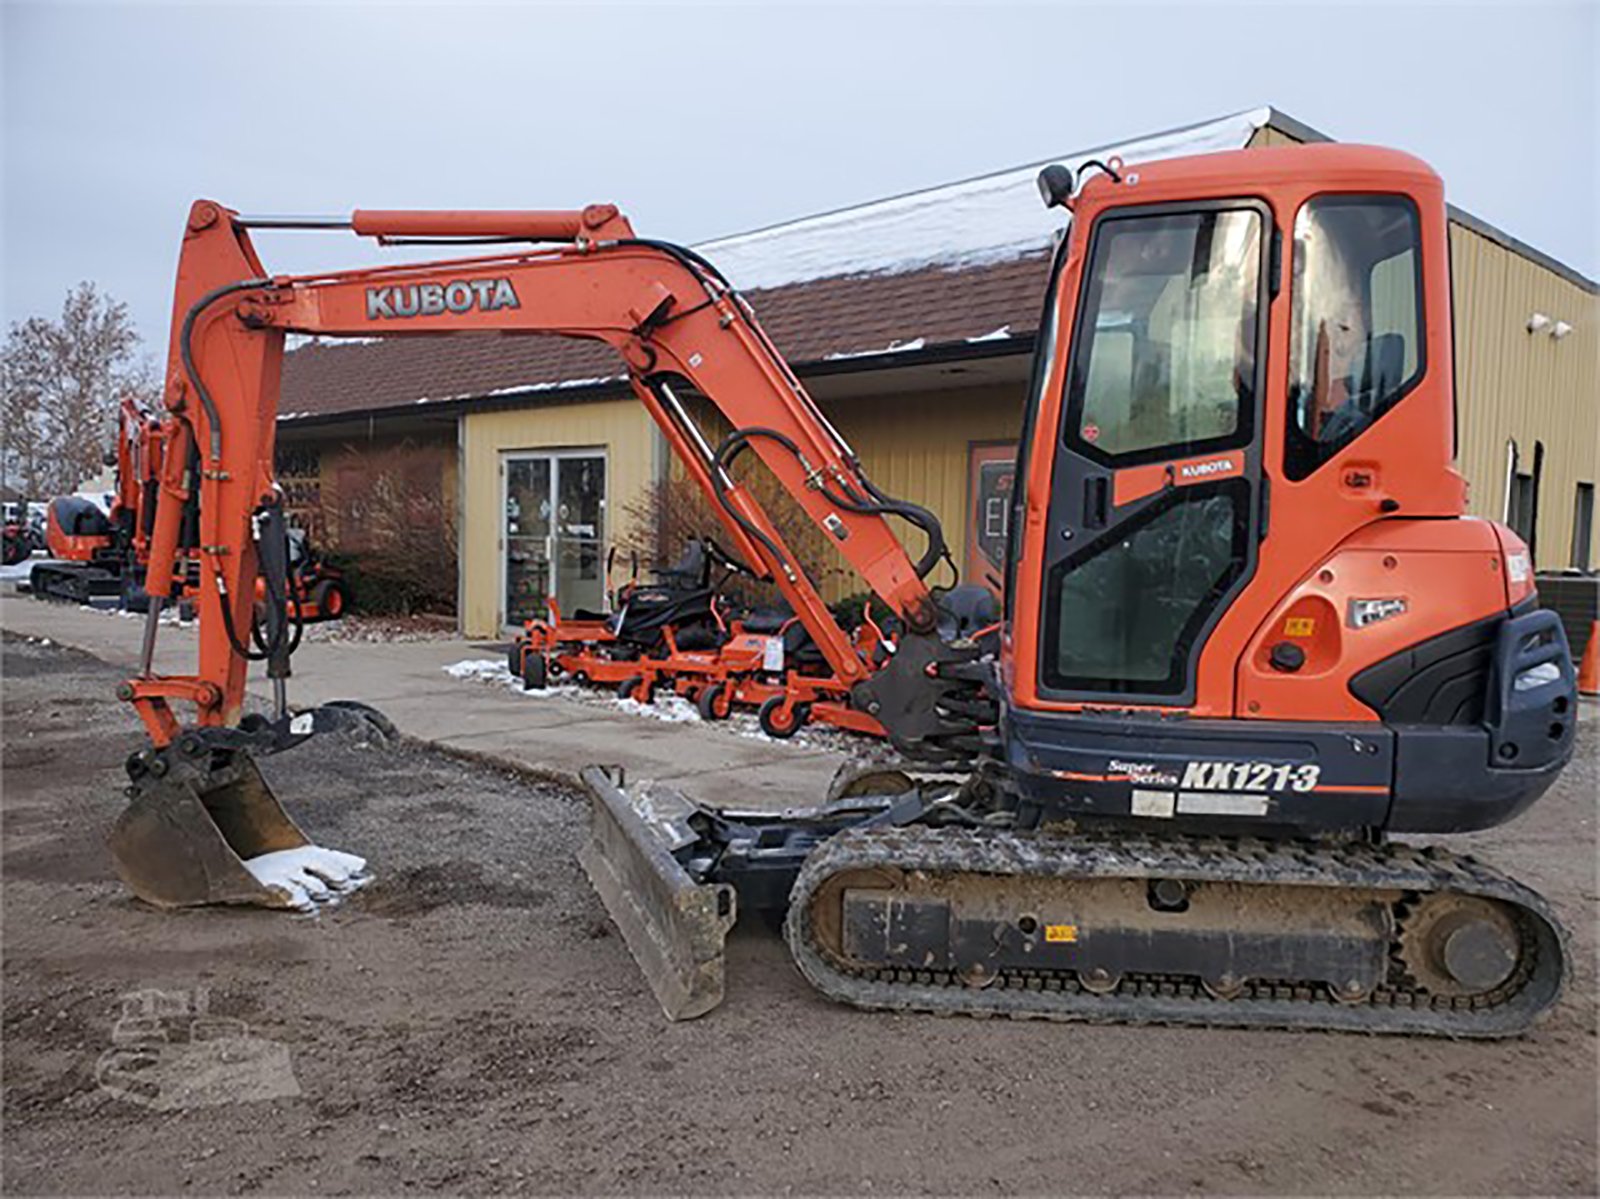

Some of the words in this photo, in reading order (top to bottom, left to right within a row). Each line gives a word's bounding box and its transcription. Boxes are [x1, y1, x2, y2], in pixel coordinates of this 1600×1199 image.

[365, 279, 521, 320] KUBOTA
[1181, 460, 1232, 477] KUBOTA
[1108, 760, 1155, 773] Super
[1131, 772, 1178, 786] Series
[1180, 761, 1321, 792] KX121-3
